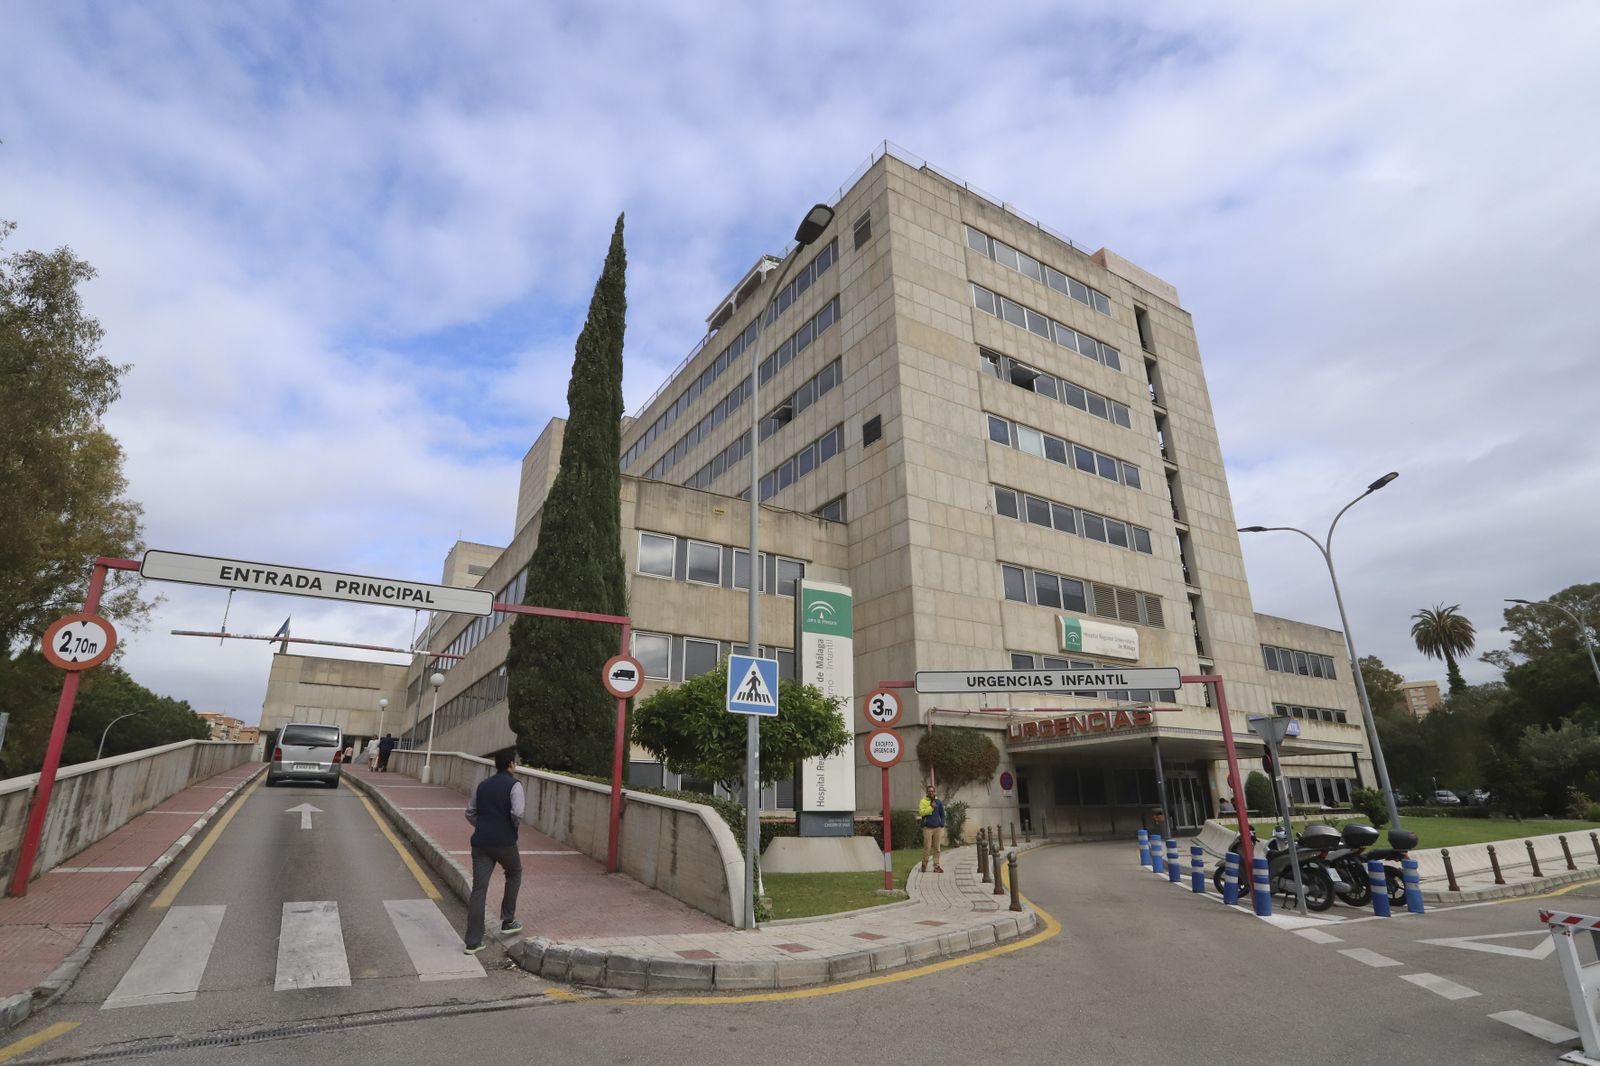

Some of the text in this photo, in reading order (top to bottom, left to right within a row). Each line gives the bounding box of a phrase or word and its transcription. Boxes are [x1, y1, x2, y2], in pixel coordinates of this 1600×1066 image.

[219, 565, 435, 604] ENTRADA PRINCIPAL
[59, 630, 98, 655] 2,70m
[815, 639, 825, 669] Málaga
[825, 639, 834, 670] Infantil
[816, 672, 825, 683] de
[966, 673, 1129, 688] URGENCIAS INFANTIL
[1007, 706, 1153, 741] URGENCIAS
[816, 774, 827, 807] Hospital
